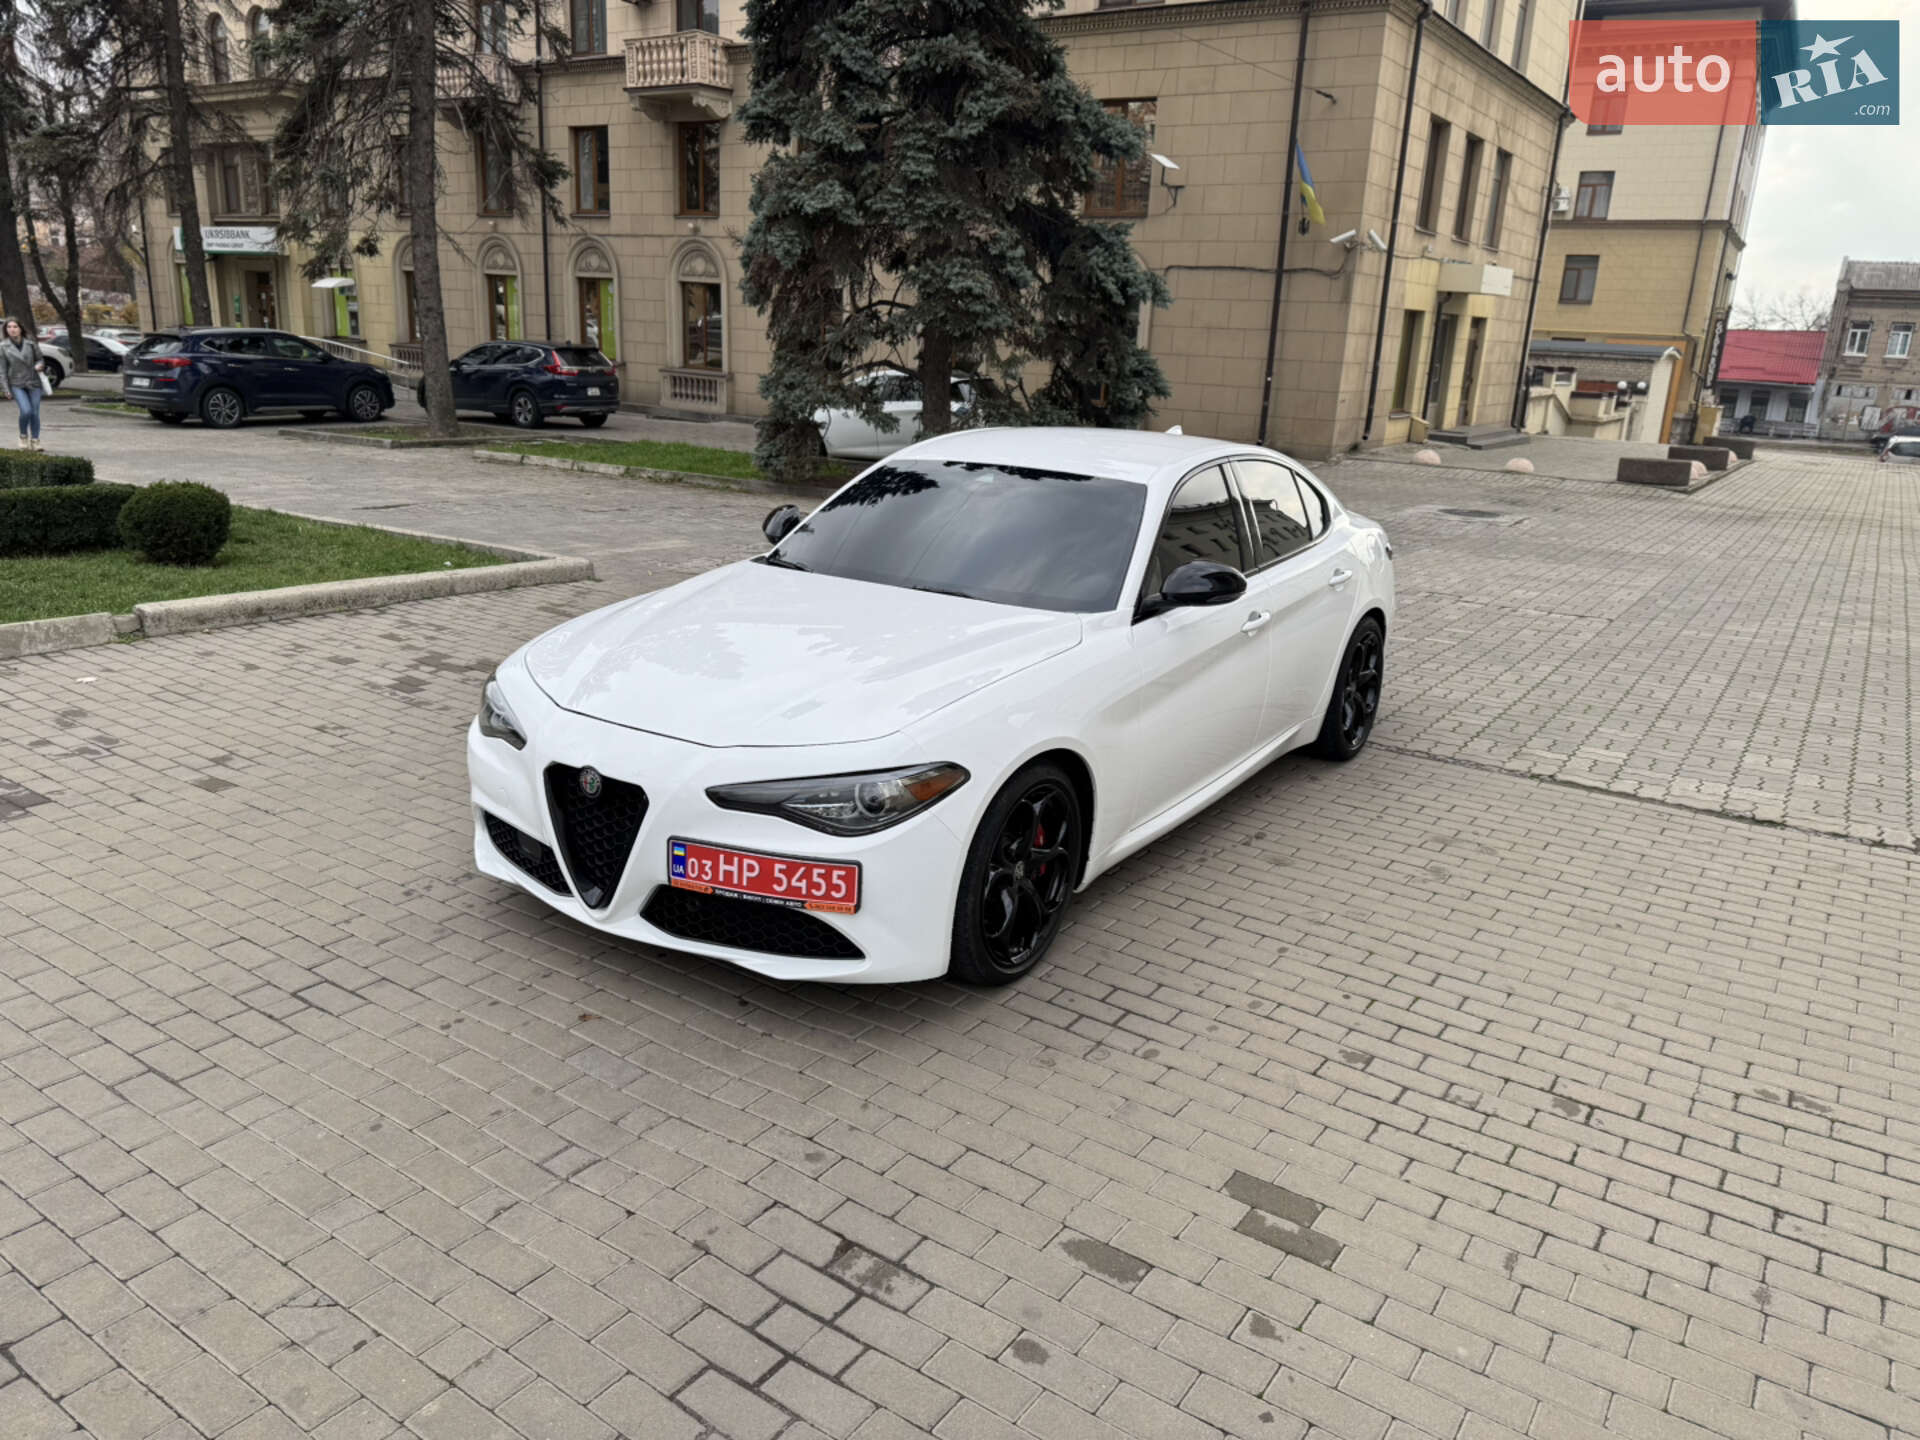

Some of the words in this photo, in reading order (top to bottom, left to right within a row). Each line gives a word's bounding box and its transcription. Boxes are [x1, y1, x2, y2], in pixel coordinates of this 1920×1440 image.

[673, 864, 685, 875] UA
[687, 857, 713, 881] 03
[719, 854, 760, 887] HP
[772, 863, 847, 899] 5455
